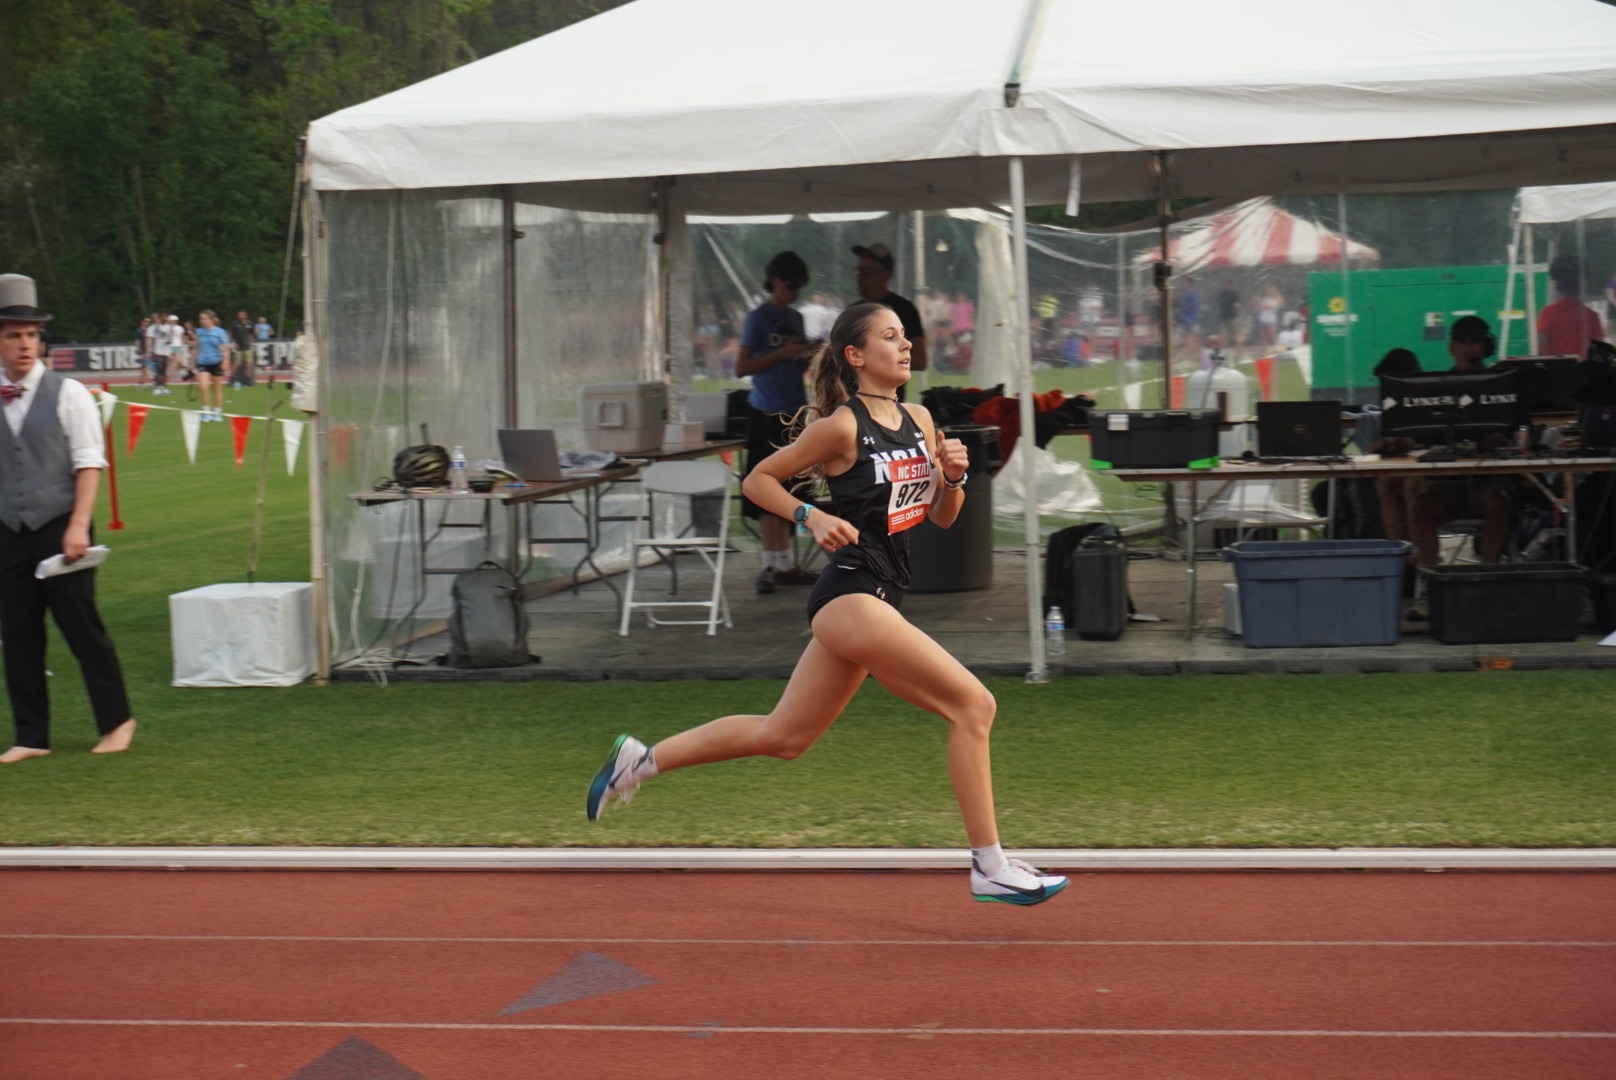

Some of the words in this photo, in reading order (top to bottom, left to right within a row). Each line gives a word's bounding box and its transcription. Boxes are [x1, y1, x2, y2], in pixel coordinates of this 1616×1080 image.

[88, 347, 142, 370] STRE
[897, 465, 910, 480] NC
[911, 463, 930, 478] STAT
[896, 480, 930, 508] 972
[905, 507, 924, 520] adidas
